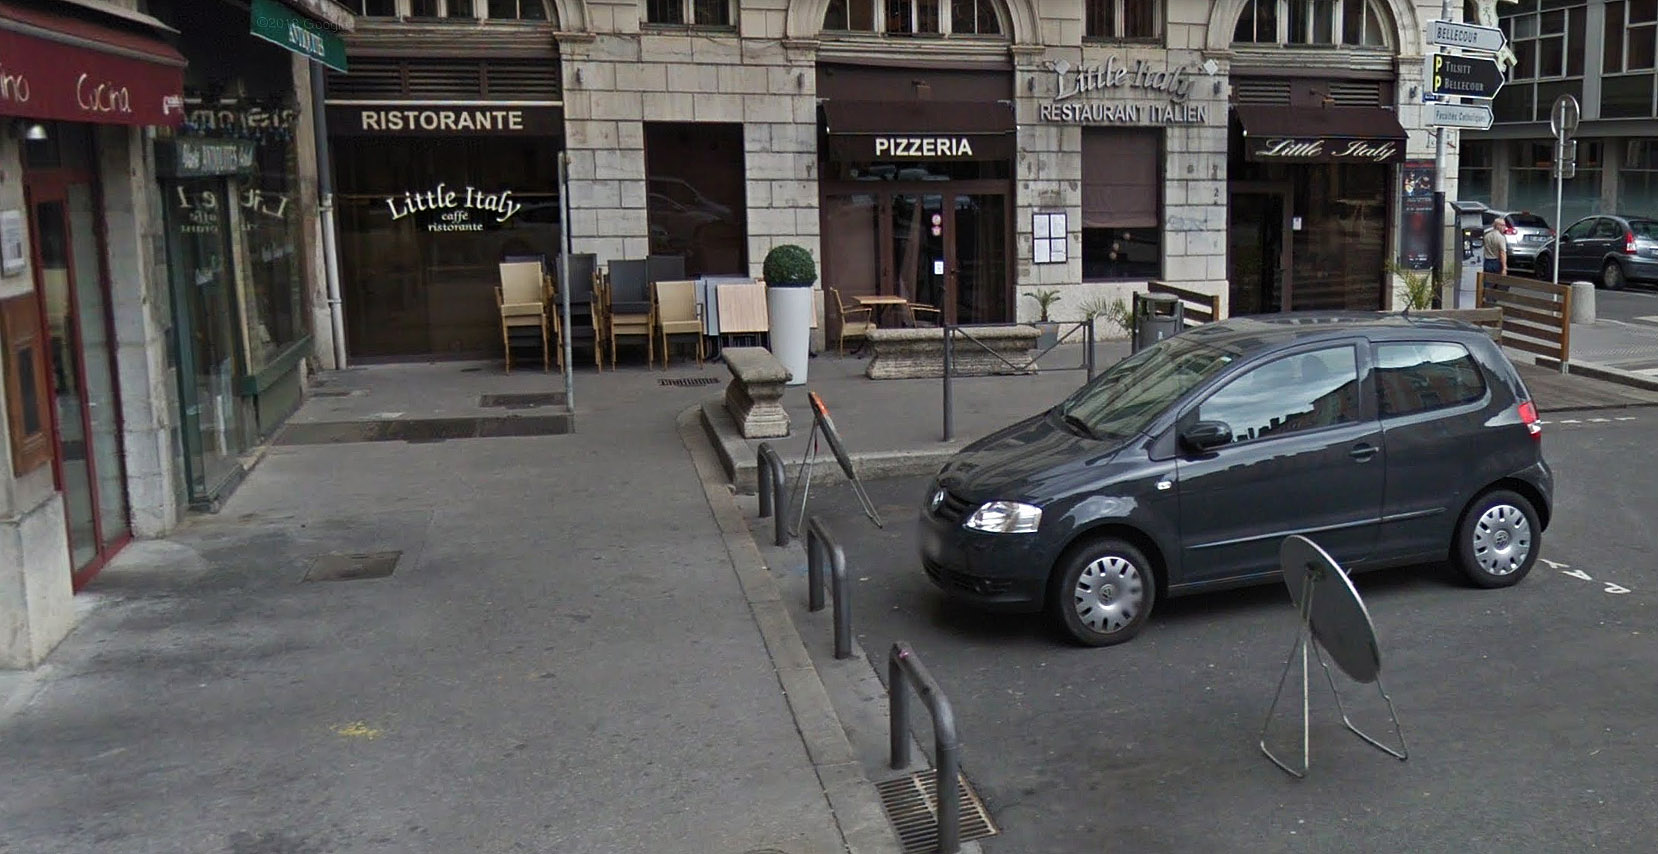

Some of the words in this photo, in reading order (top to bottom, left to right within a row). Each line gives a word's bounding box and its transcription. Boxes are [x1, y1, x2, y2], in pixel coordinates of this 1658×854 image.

[1437, 27, 1478, 43] BELLECOUR
[1435, 56, 1443, 73] P
[1054, 55, 1128, 101] Little
[1130, 59, 1196, 105] Italy
[1434, 75, 1442, 92] P
[77, 73, 132, 113] Cucina
[361, 110, 524, 130] RISTORANTE
[1040, 103, 1142, 122] RESTAURANT
[1150, 105, 1207, 123] ITALIEN
[875, 138, 973, 156] PIZZERIA
[1256, 138, 1326, 157] Little
[1331, 141, 1397, 162] Italy
[386, 182, 458, 220] Little
[463, 186, 521, 222] Italy
[427, 221, 484, 233] ristorante
